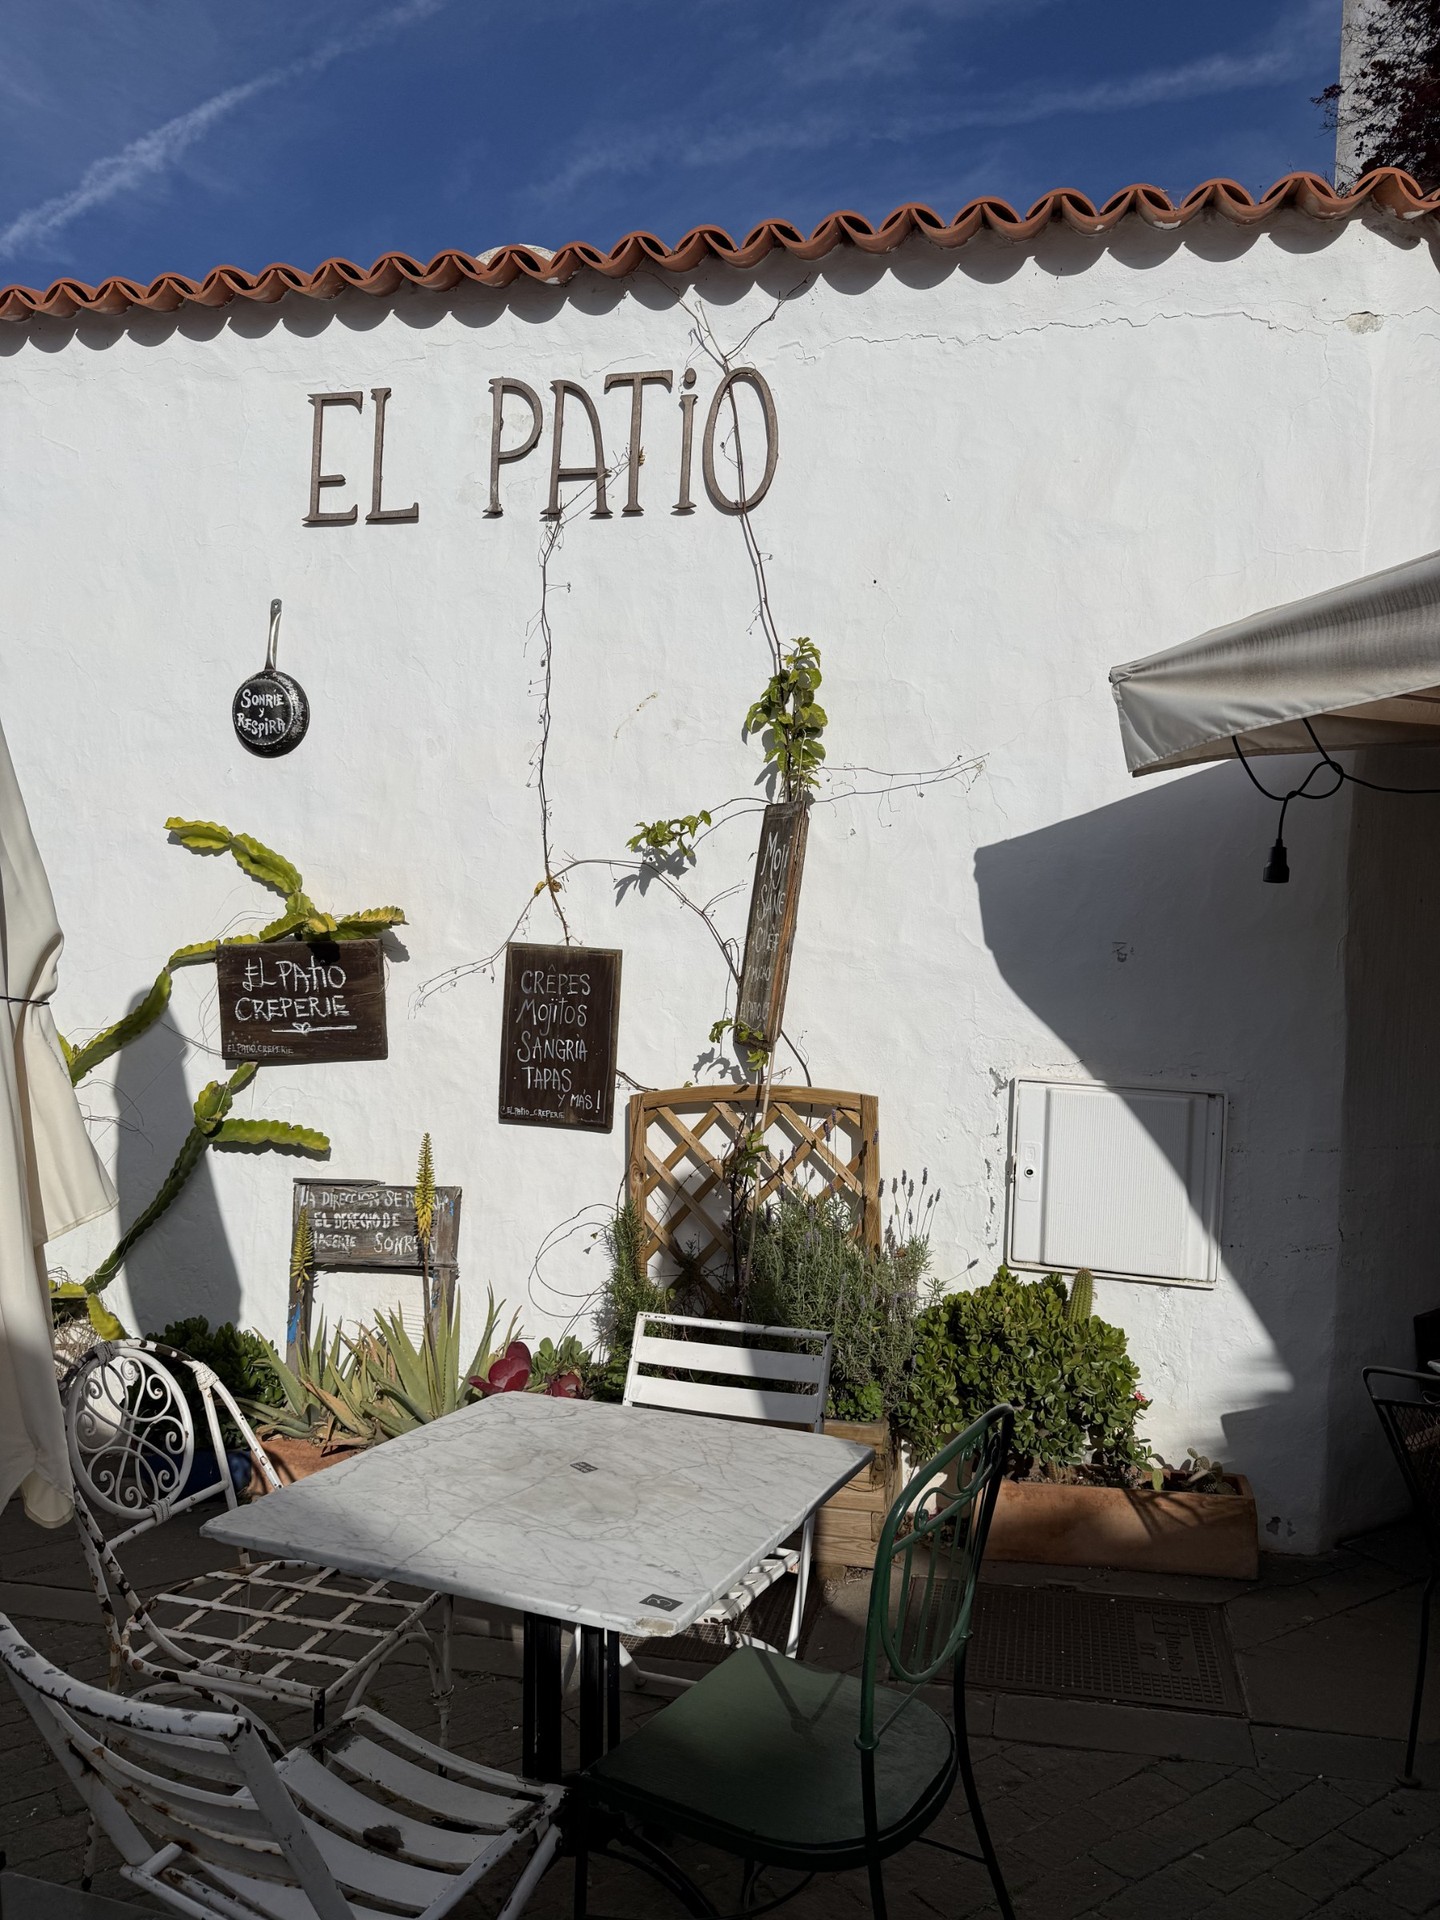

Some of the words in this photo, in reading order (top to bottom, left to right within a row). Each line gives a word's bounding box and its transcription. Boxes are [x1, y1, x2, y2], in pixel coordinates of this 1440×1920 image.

[302, 386, 420, 526] EL
[236, 712, 286, 738] RESPIRA
[242, 956, 277, 992] EL
[520, 963, 591, 996] CRÊPES
[234, 994, 350, 1022] CREPERIE
[516, 1030, 588, 1063] SANGRÍA
[521, 1065, 572, 1093] TAPAS
[384, 1189, 403, 1208] SE
[313, 1211, 333, 1229] EL
[382, 1212, 401, 1229] DE
